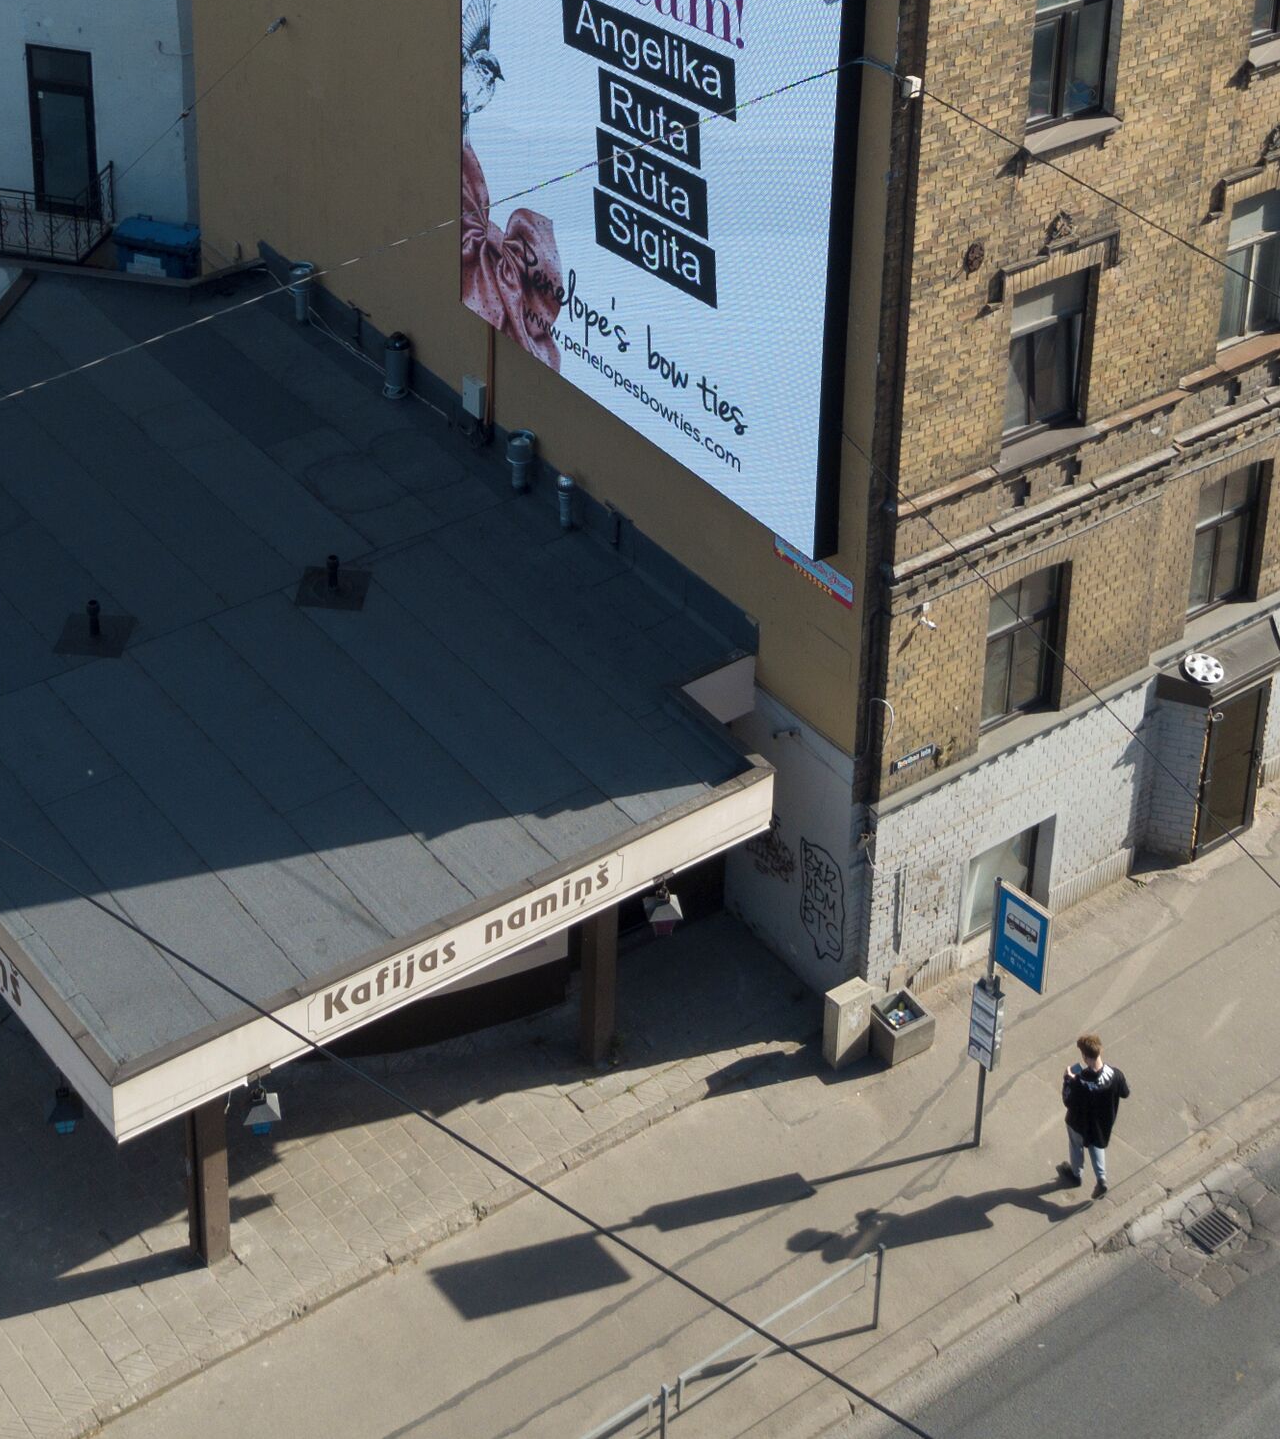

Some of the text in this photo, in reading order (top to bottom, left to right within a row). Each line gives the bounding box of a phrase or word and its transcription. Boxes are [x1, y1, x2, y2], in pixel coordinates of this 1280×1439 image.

[575, 0, 723, 99] Angelika
[609, 81, 689, 155] Ruta
[612, 144, 691, 221] Rūta
[609, 203, 702, 286] Sigita
[521, 237, 749, 436] Penelope's bow ties
[523, 305, 742, 473] www.penelopesbowties.com
[322, 863, 611, 1021] Kafijas namiņš
